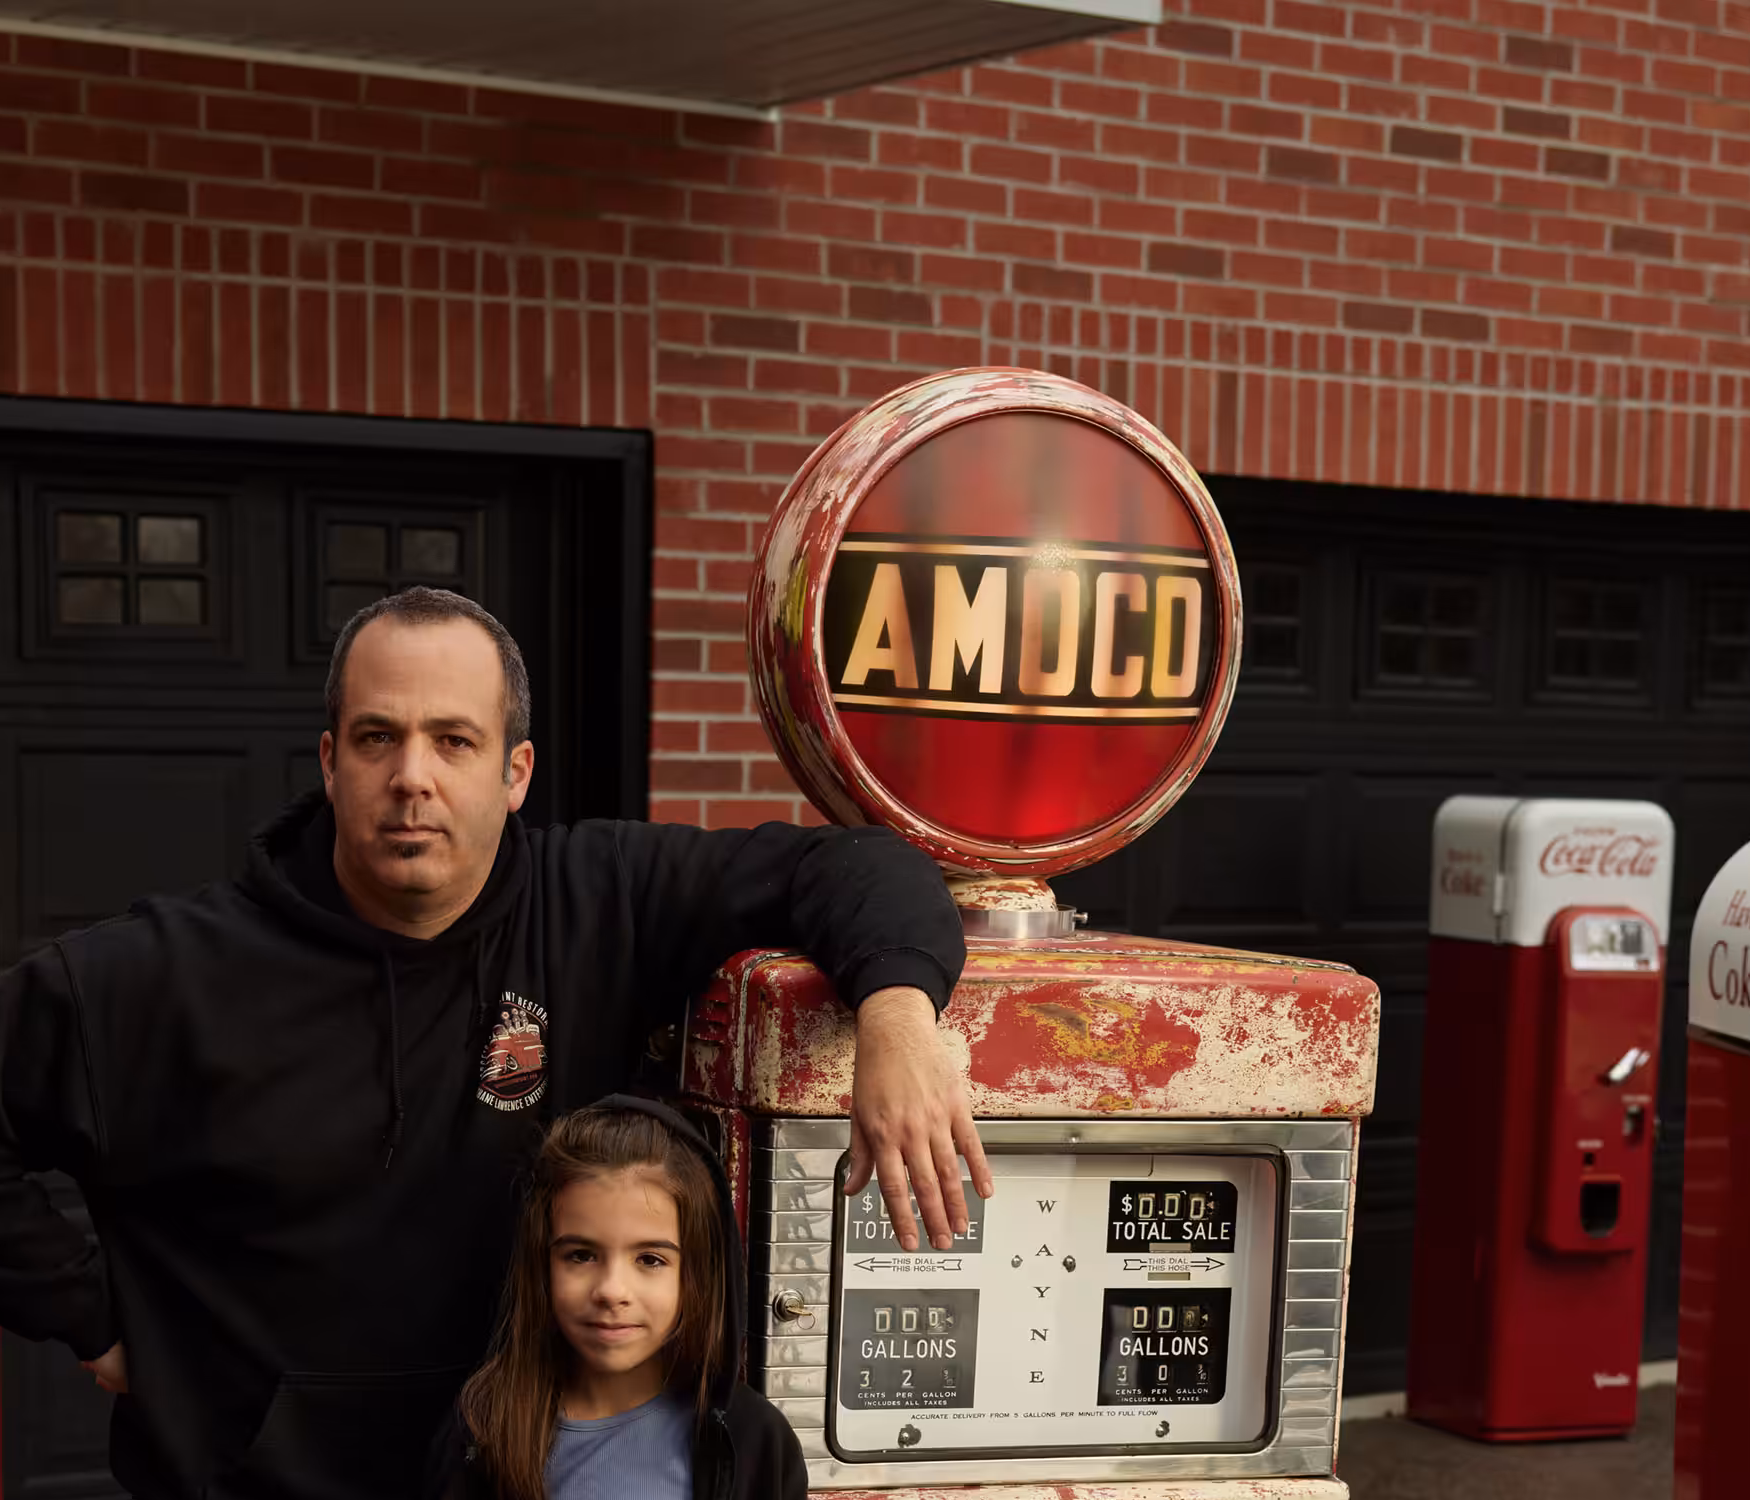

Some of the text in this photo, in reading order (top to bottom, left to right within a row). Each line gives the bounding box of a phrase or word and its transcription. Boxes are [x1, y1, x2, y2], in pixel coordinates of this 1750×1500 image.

[840, 563, 1202, 698] AMOCO
[1539, 834, 1661, 877] Coca-Cola
[501, 991, 515, 1003] INT
[853, 1221, 895, 1239] TOT
[1112, 1221, 1231, 1240] TOTAL SALE
[861, 1338, 957, 1358] GALLONS
[1120, 1336, 1208, 1356] GALLONS
[902, 1369, 913, 1387] 2
[1158, 1364, 1168, 1381] 0
